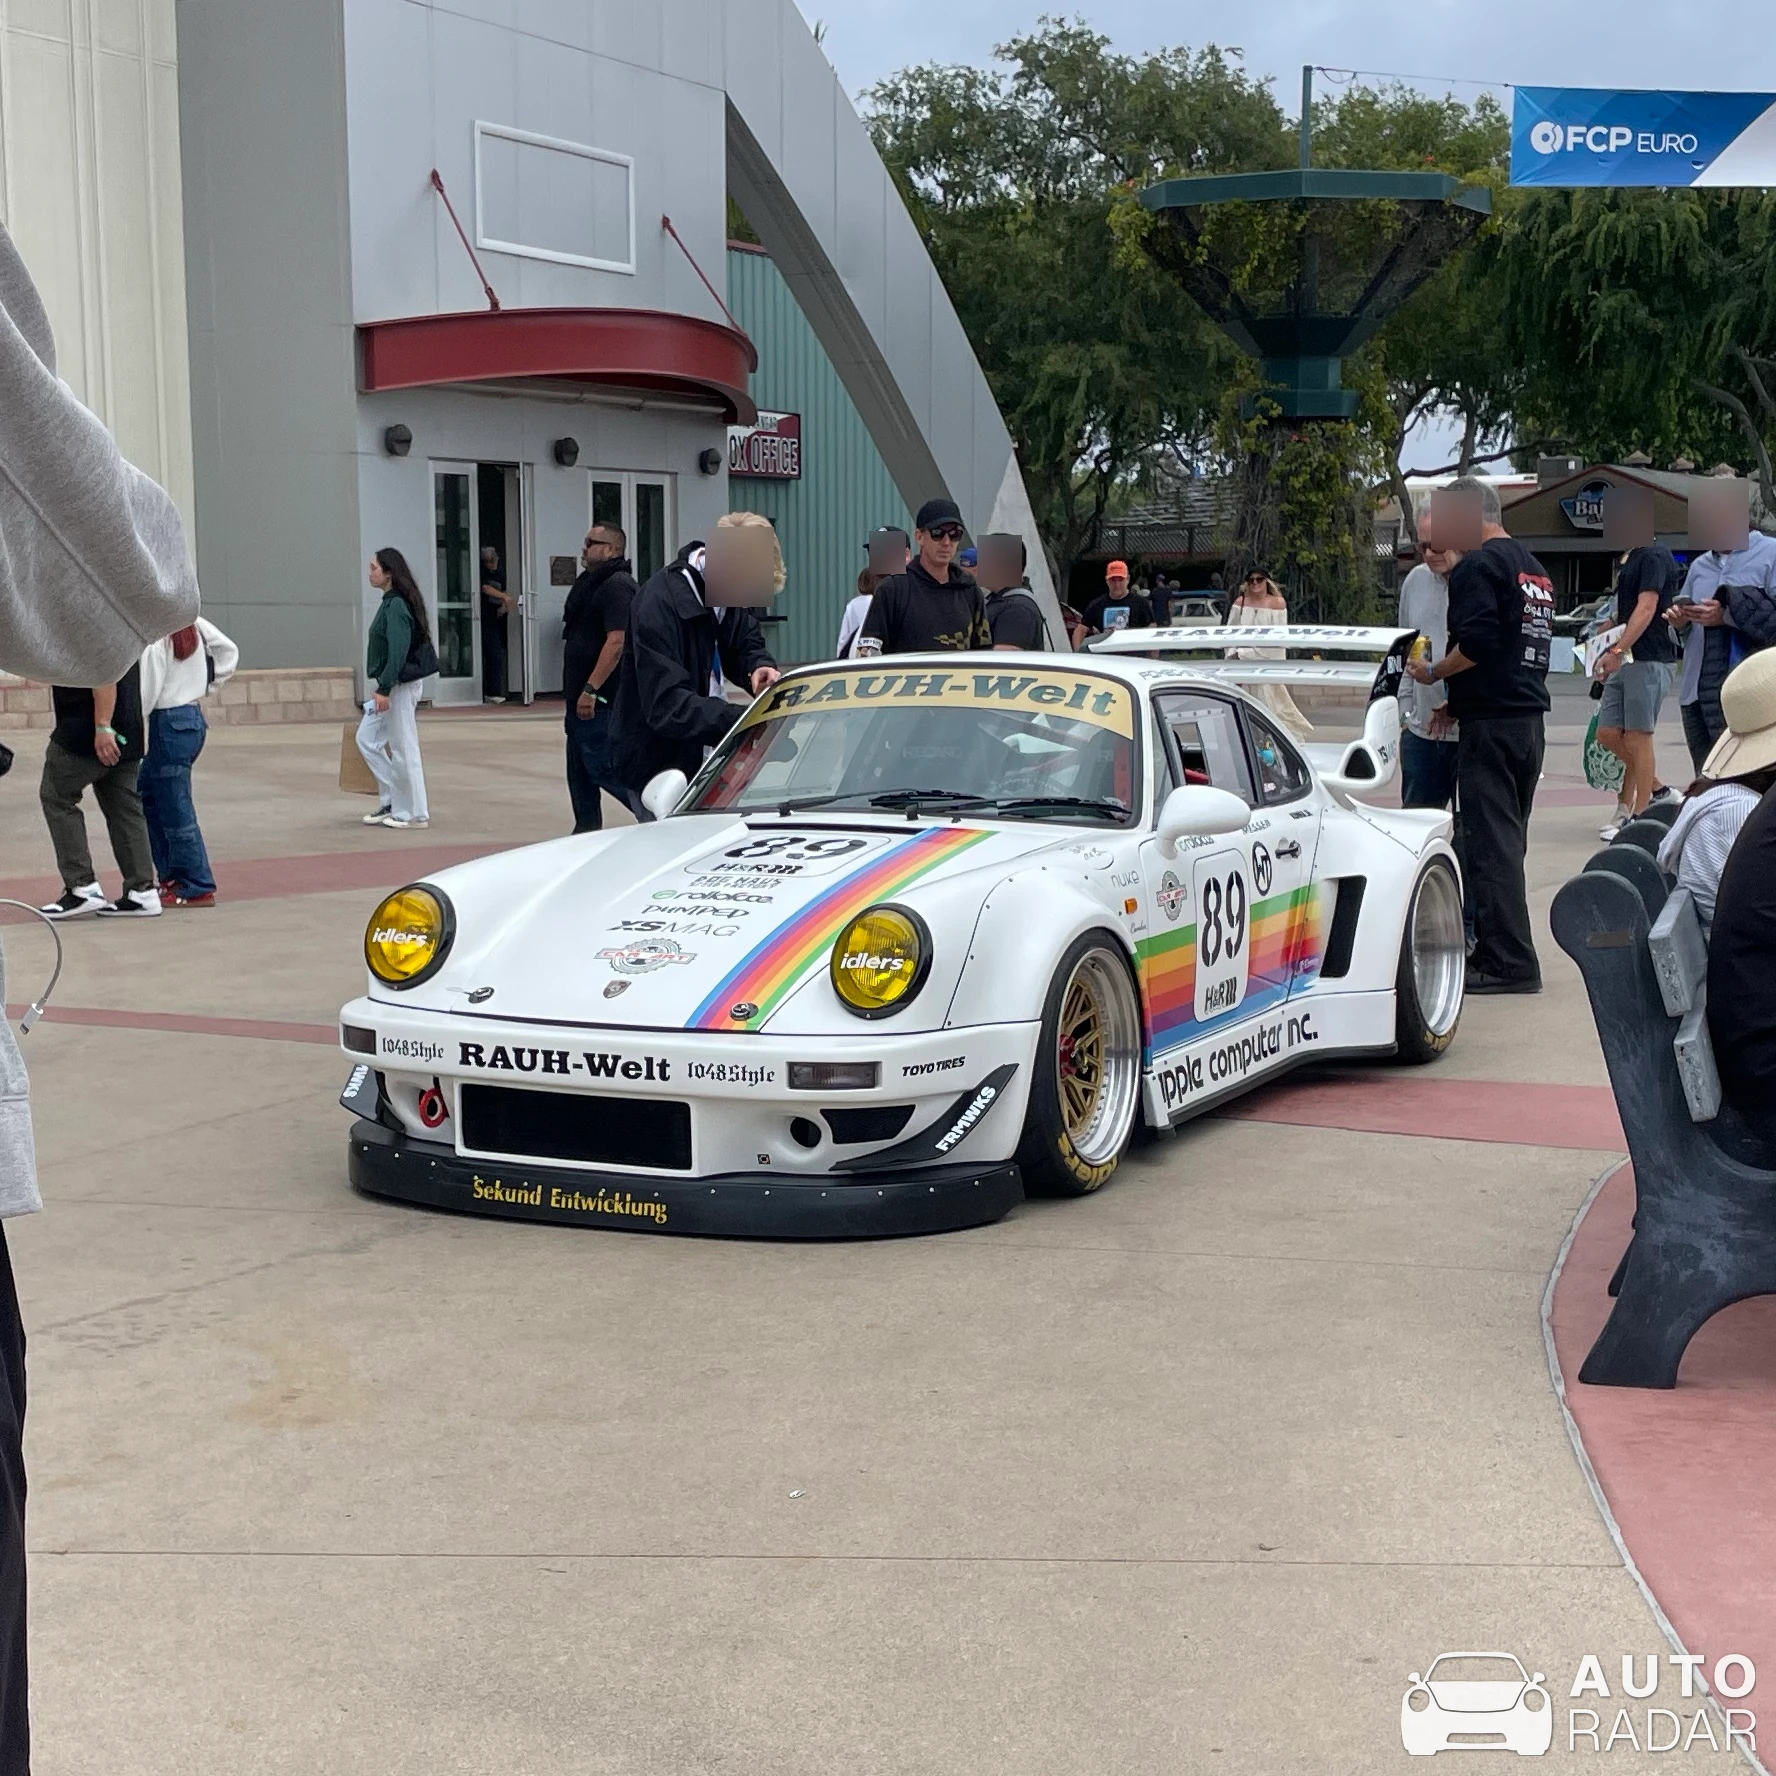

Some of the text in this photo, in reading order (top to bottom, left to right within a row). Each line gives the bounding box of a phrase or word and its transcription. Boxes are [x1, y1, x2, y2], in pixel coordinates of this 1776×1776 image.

[1566, 125, 1698, 154] FCP EURO
[729, 434, 799, 475] OX OFFICE
[1575, 499, 1604, 517] Baj
[762, 673, 1117, 717] RAUH-Welt
[724, 836, 868, 860] 89
[1201, 870, 1245, 967] 89
[372, 928, 428, 946] idlers
[840, 952, 904, 971] idlers
[381, 1036, 444, 1062] 1048Style
[459, 1041, 671, 1082] RAUH-Welt
[1208, 1023, 1282, 1082] computer
[1287, 1013, 1319, 1048] inc.
[687, 1061, 776, 1087] 1048Style
[902, 1056, 966, 1077] TOYO TIRES
[935, 1085, 996, 1152] FRMWKS
[472, 1177, 668, 1224] Sekund Entwicklung
